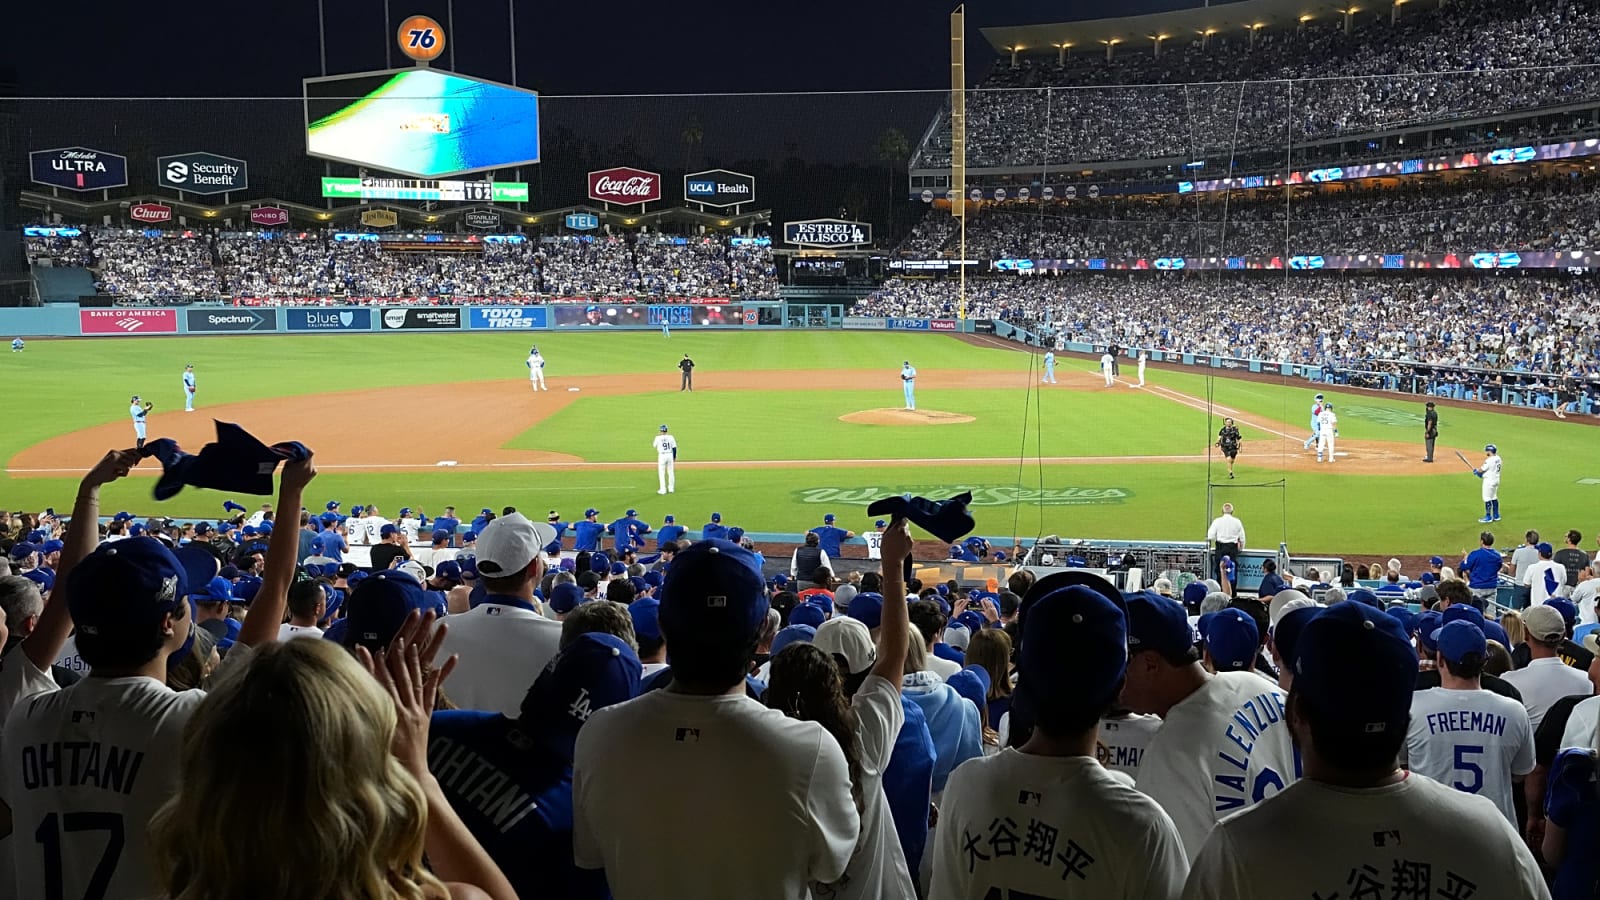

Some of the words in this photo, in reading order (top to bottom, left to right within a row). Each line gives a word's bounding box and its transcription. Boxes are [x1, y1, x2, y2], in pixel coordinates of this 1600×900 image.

[407, 28, 436, 49] 76
[52, 159, 107, 173] ULTRA
[192, 162, 239, 176] Security
[193, 174, 234, 185] Benefit
[595, 175, 653, 197] Coca-Cola
[690, 183, 713, 193] UCLA
[717, 183, 749, 194] Health
[132, 207, 169, 219] Churu
[569, 216, 595, 227] TEL
[792, 233, 849, 243] JALISCO
[306, 312, 339, 324] blue
[416, 312, 457, 320] smartwater
[481, 308, 523, 319] TOYO
[745, 312, 756, 322] 76
[208, 314, 254, 325] Spectrum
[488, 317, 533, 328] TIRES
[932, 321, 955, 329] Yakult
[1427, 711, 1506, 737] FREEMAN
[22, 742, 145, 795] OHTANI
[1454, 744, 1484, 794] 5
[964, 816, 1095, 881] 大谷翔平
[35, 812, 125, 900] 17
